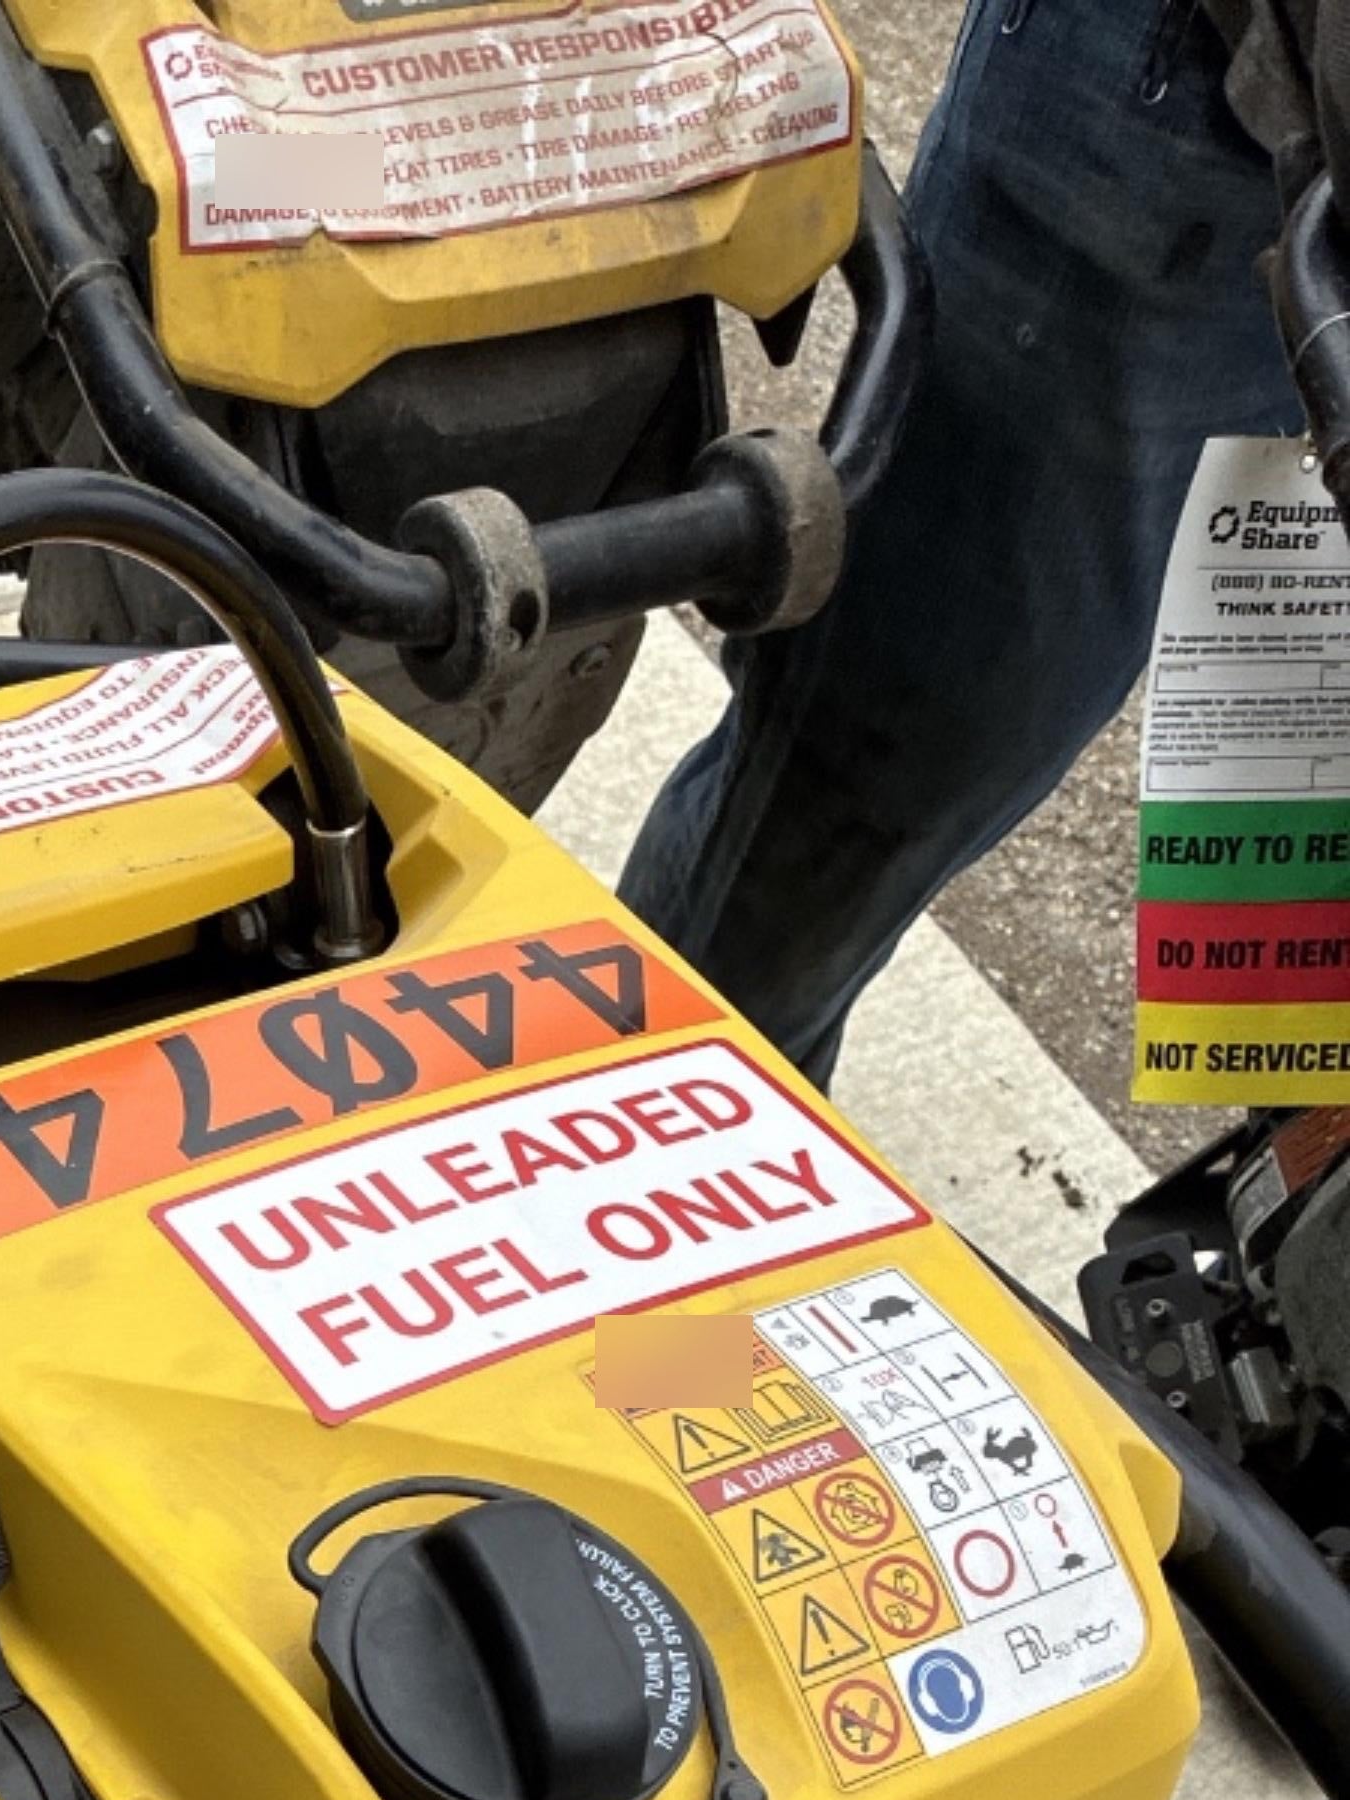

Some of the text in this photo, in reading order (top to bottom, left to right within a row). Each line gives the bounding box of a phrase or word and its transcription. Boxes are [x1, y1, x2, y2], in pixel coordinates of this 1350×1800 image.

[301, 43, 504, 98] CUSTOMER
[511, 0, 757, 66] RESPONSIBI
[480, 103, 562, 131] GREASE
[566, 86, 626, 116] DAILY
[630, 68, 712, 107] BEFORE
[384, 163, 431, 186] FLAT
[438, 150, 503, 176] TIRES
[518, 138, 569, 164] TIRE
[573, 121, 662, 153] DAMAGE
[480, 174, 574, 208] BATTERY
[578, 138, 734, 192] MAINTENANCE
[1216, 602, 1277, 617] THINK
[62, 649, 209, 746] INSURANCE
[98, 673, 135, 704] TO
[142, 700, 189, 737] ALL
[62, 732, 143, 766] FLUID
[1146, 835, 1247, 866] READY
[1254, 837, 1293, 864] TO
[1157, 938, 1194, 969] DO
[1204, 941, 1266, 970] NOT
[1145, 1042, 1199, 1071] NOT
[215, 1076, 756, 1273] UNLEADED
[297, 1147, 838, 1368] FUEL ONLY
[742, 1441, 842, 1490] DANGER
[593, 1573, 665, 1699] TURN TO CLICK
[629, 1579, 683, 1646] SYSTEM
[665, 1649, 692, 1727] PREVENT
[653, 1725, 681, 1751] TO
